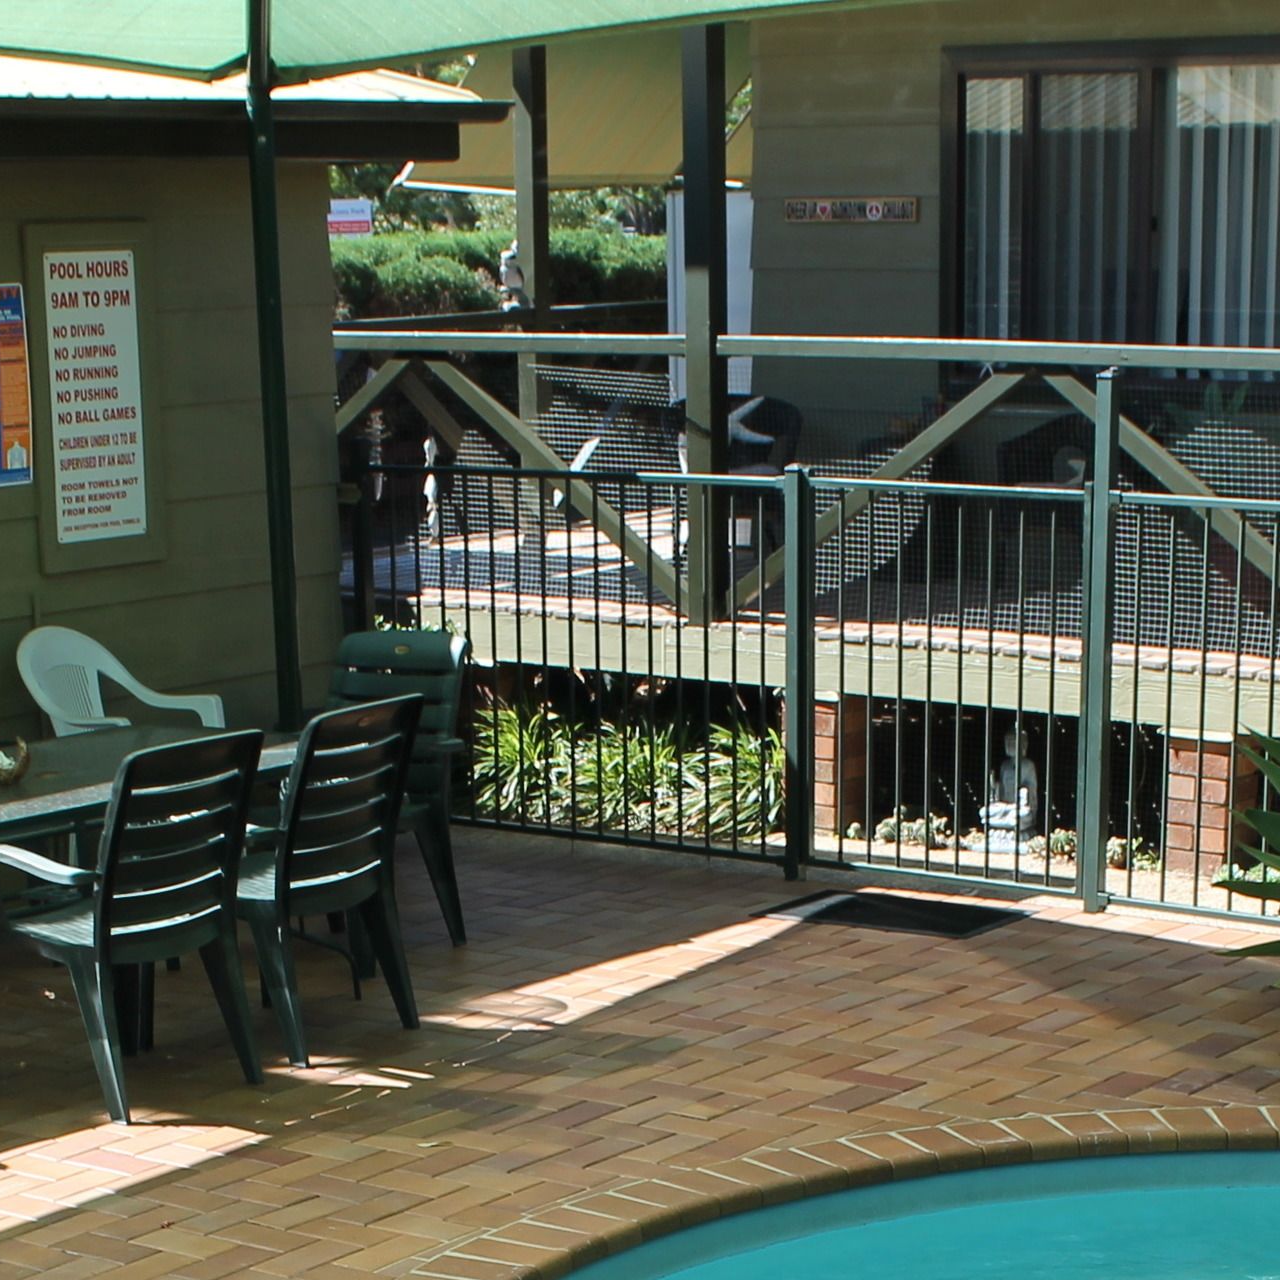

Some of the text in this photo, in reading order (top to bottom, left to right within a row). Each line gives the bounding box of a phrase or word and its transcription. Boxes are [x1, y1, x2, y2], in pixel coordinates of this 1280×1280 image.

[50, 260, 129, 280] POOL HOURS
[51, 290, 130, 309] 9AM TO 9PM
[53, 323, 105, 339] NO DIVING
[55, 344, 117, 360] NO JUMPING
[56, 366, 118, 382] NO RUNNING
[57, 387, 118, 403] NO PUSHING
[58, 406, 137, 425] NO BALL GAMES
[60, 432, 137, 450] CHILDREN UNDER 12 TO BE
[60, 452, 135, 471] SUPERVISED BY AN ADULT
[61, 477, 139, 492] ROOM TOWELS NOT
[62, 491, 127, 505] TO BE REMOVED
[62, 505, 112, 517] FROM ROOM
